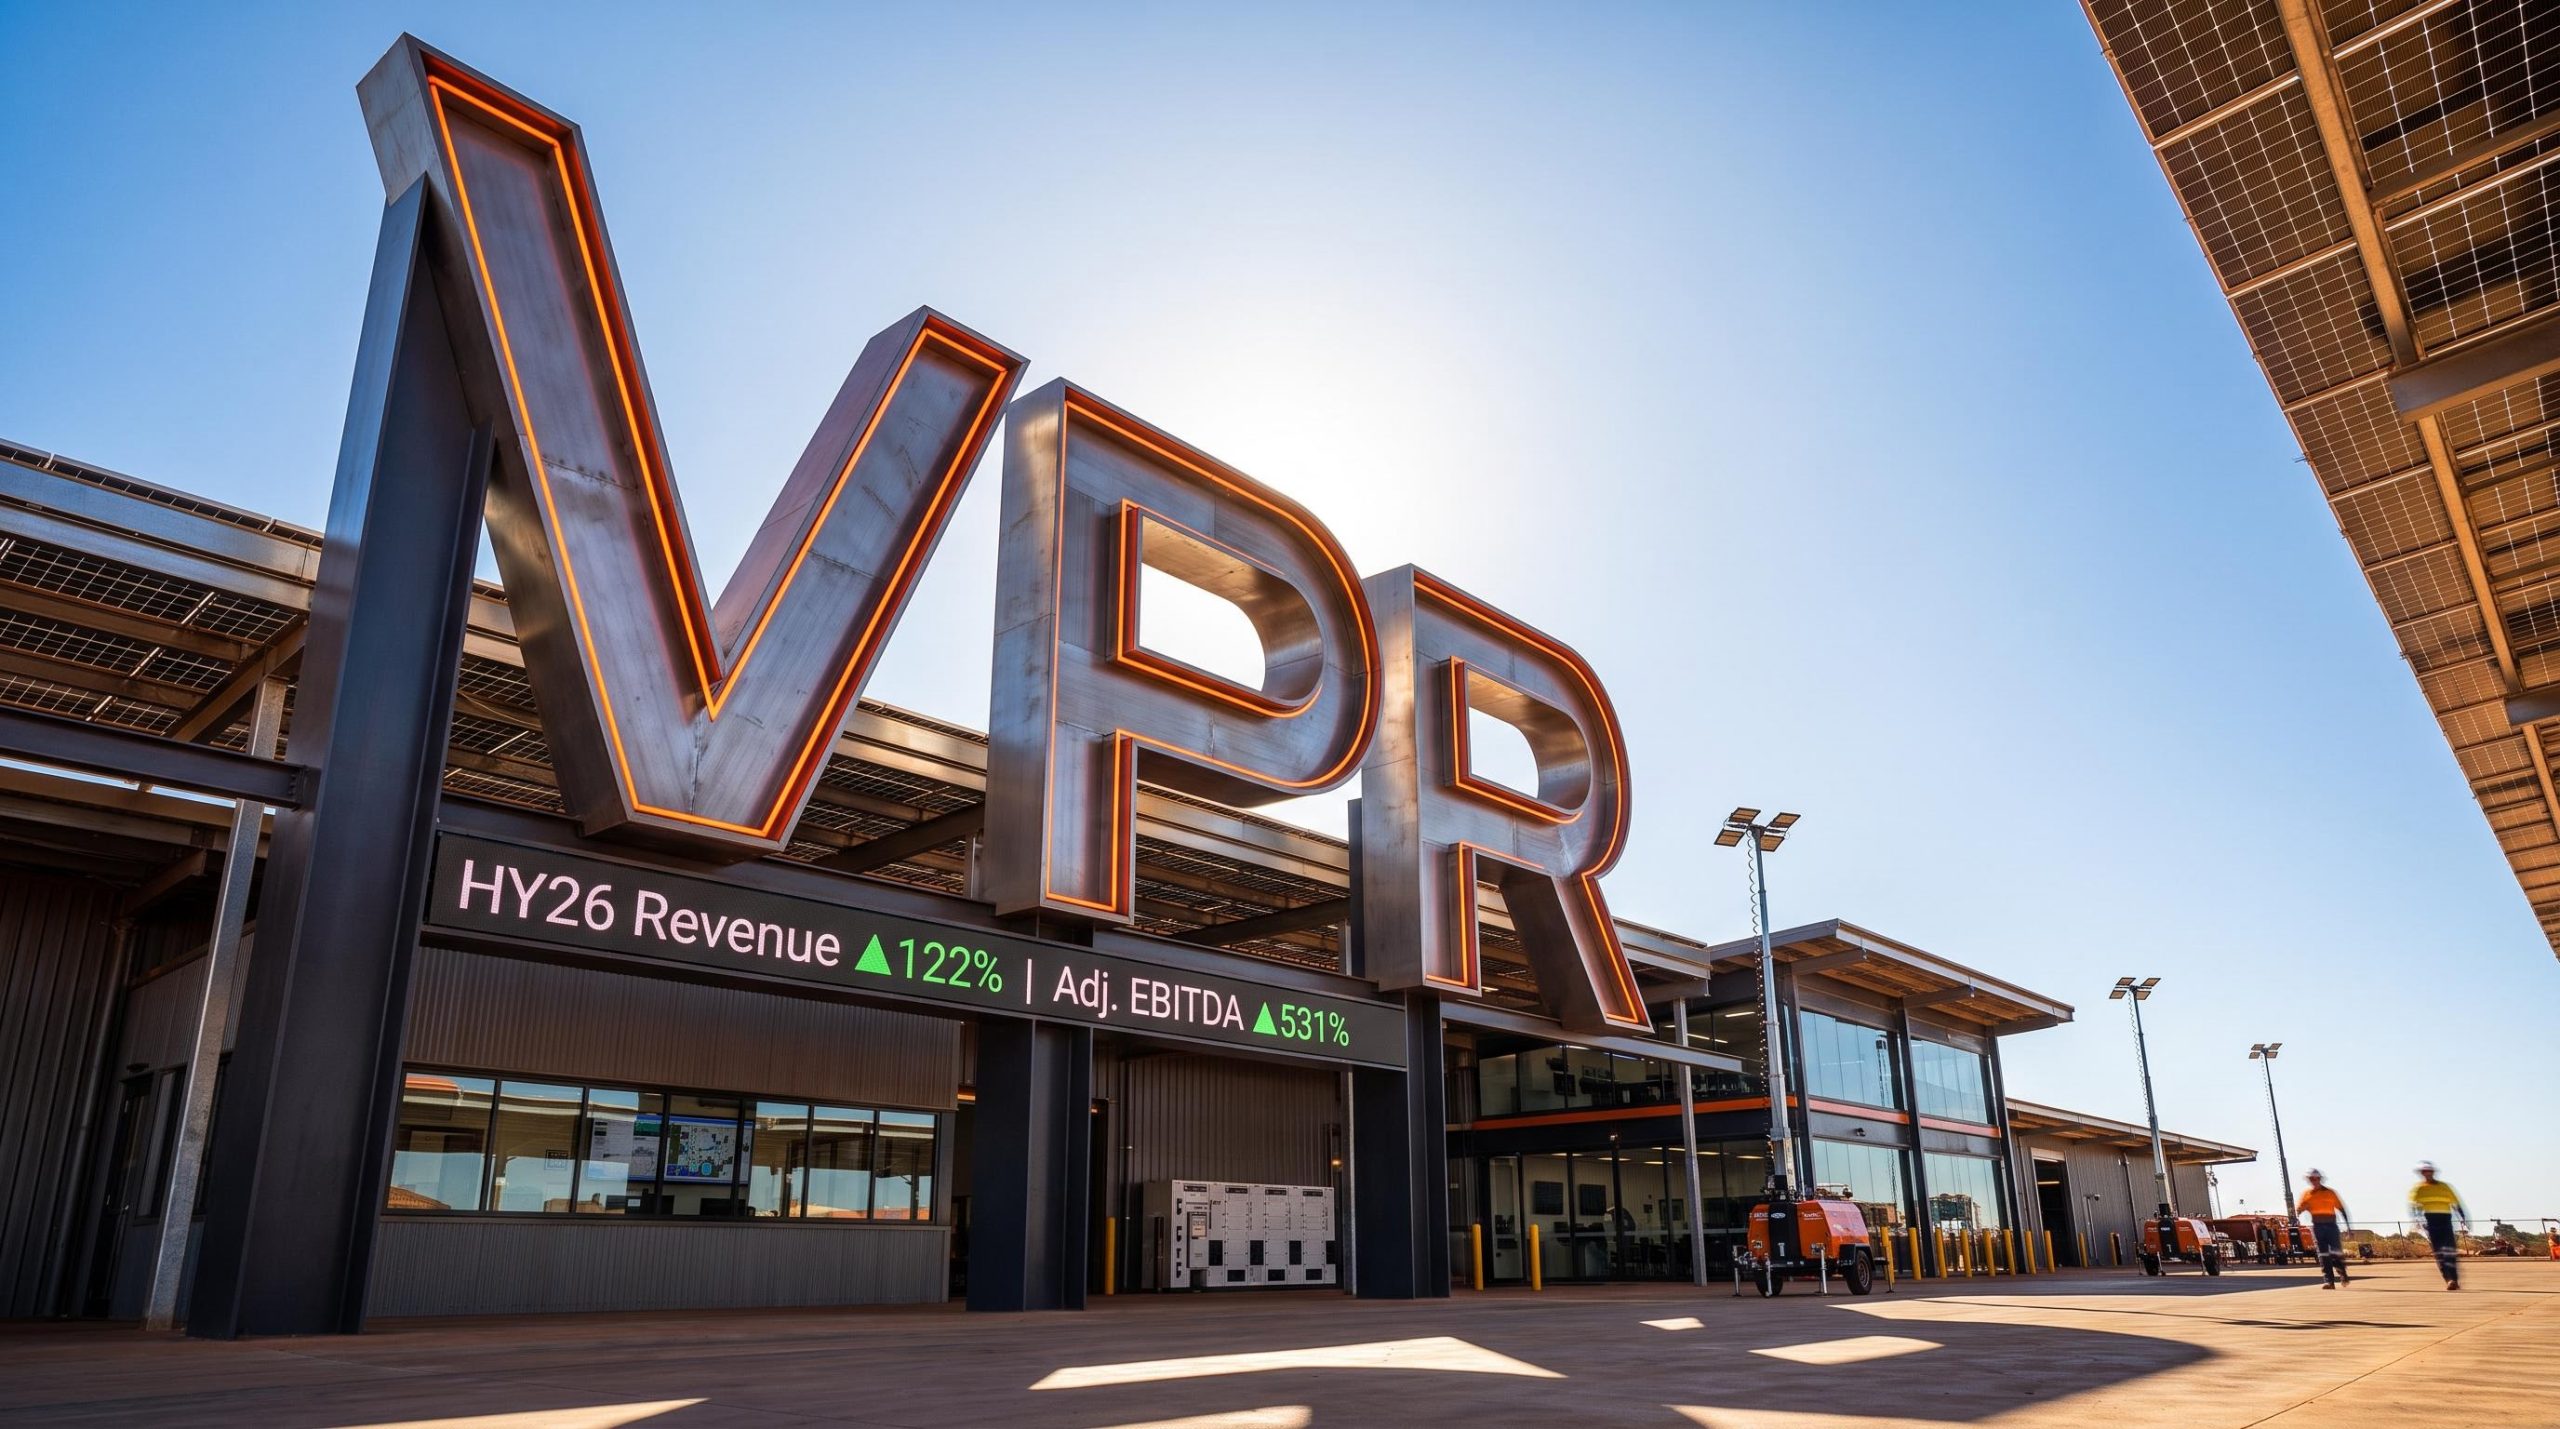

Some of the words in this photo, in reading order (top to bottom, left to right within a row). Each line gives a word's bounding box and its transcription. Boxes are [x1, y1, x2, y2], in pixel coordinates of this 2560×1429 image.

[356, 32, 1655, 1031] VPR
[458, 859, 616, 931] HY26
[633, 889, 841, 967] Revenue
[898, 938, 1004, 993] 122%
[1052, 965, 1118, 1019] Adj.
[1130, 977, 1245, 1031] EBITDA
[1280, 1003, 1350, 1047] 531%
